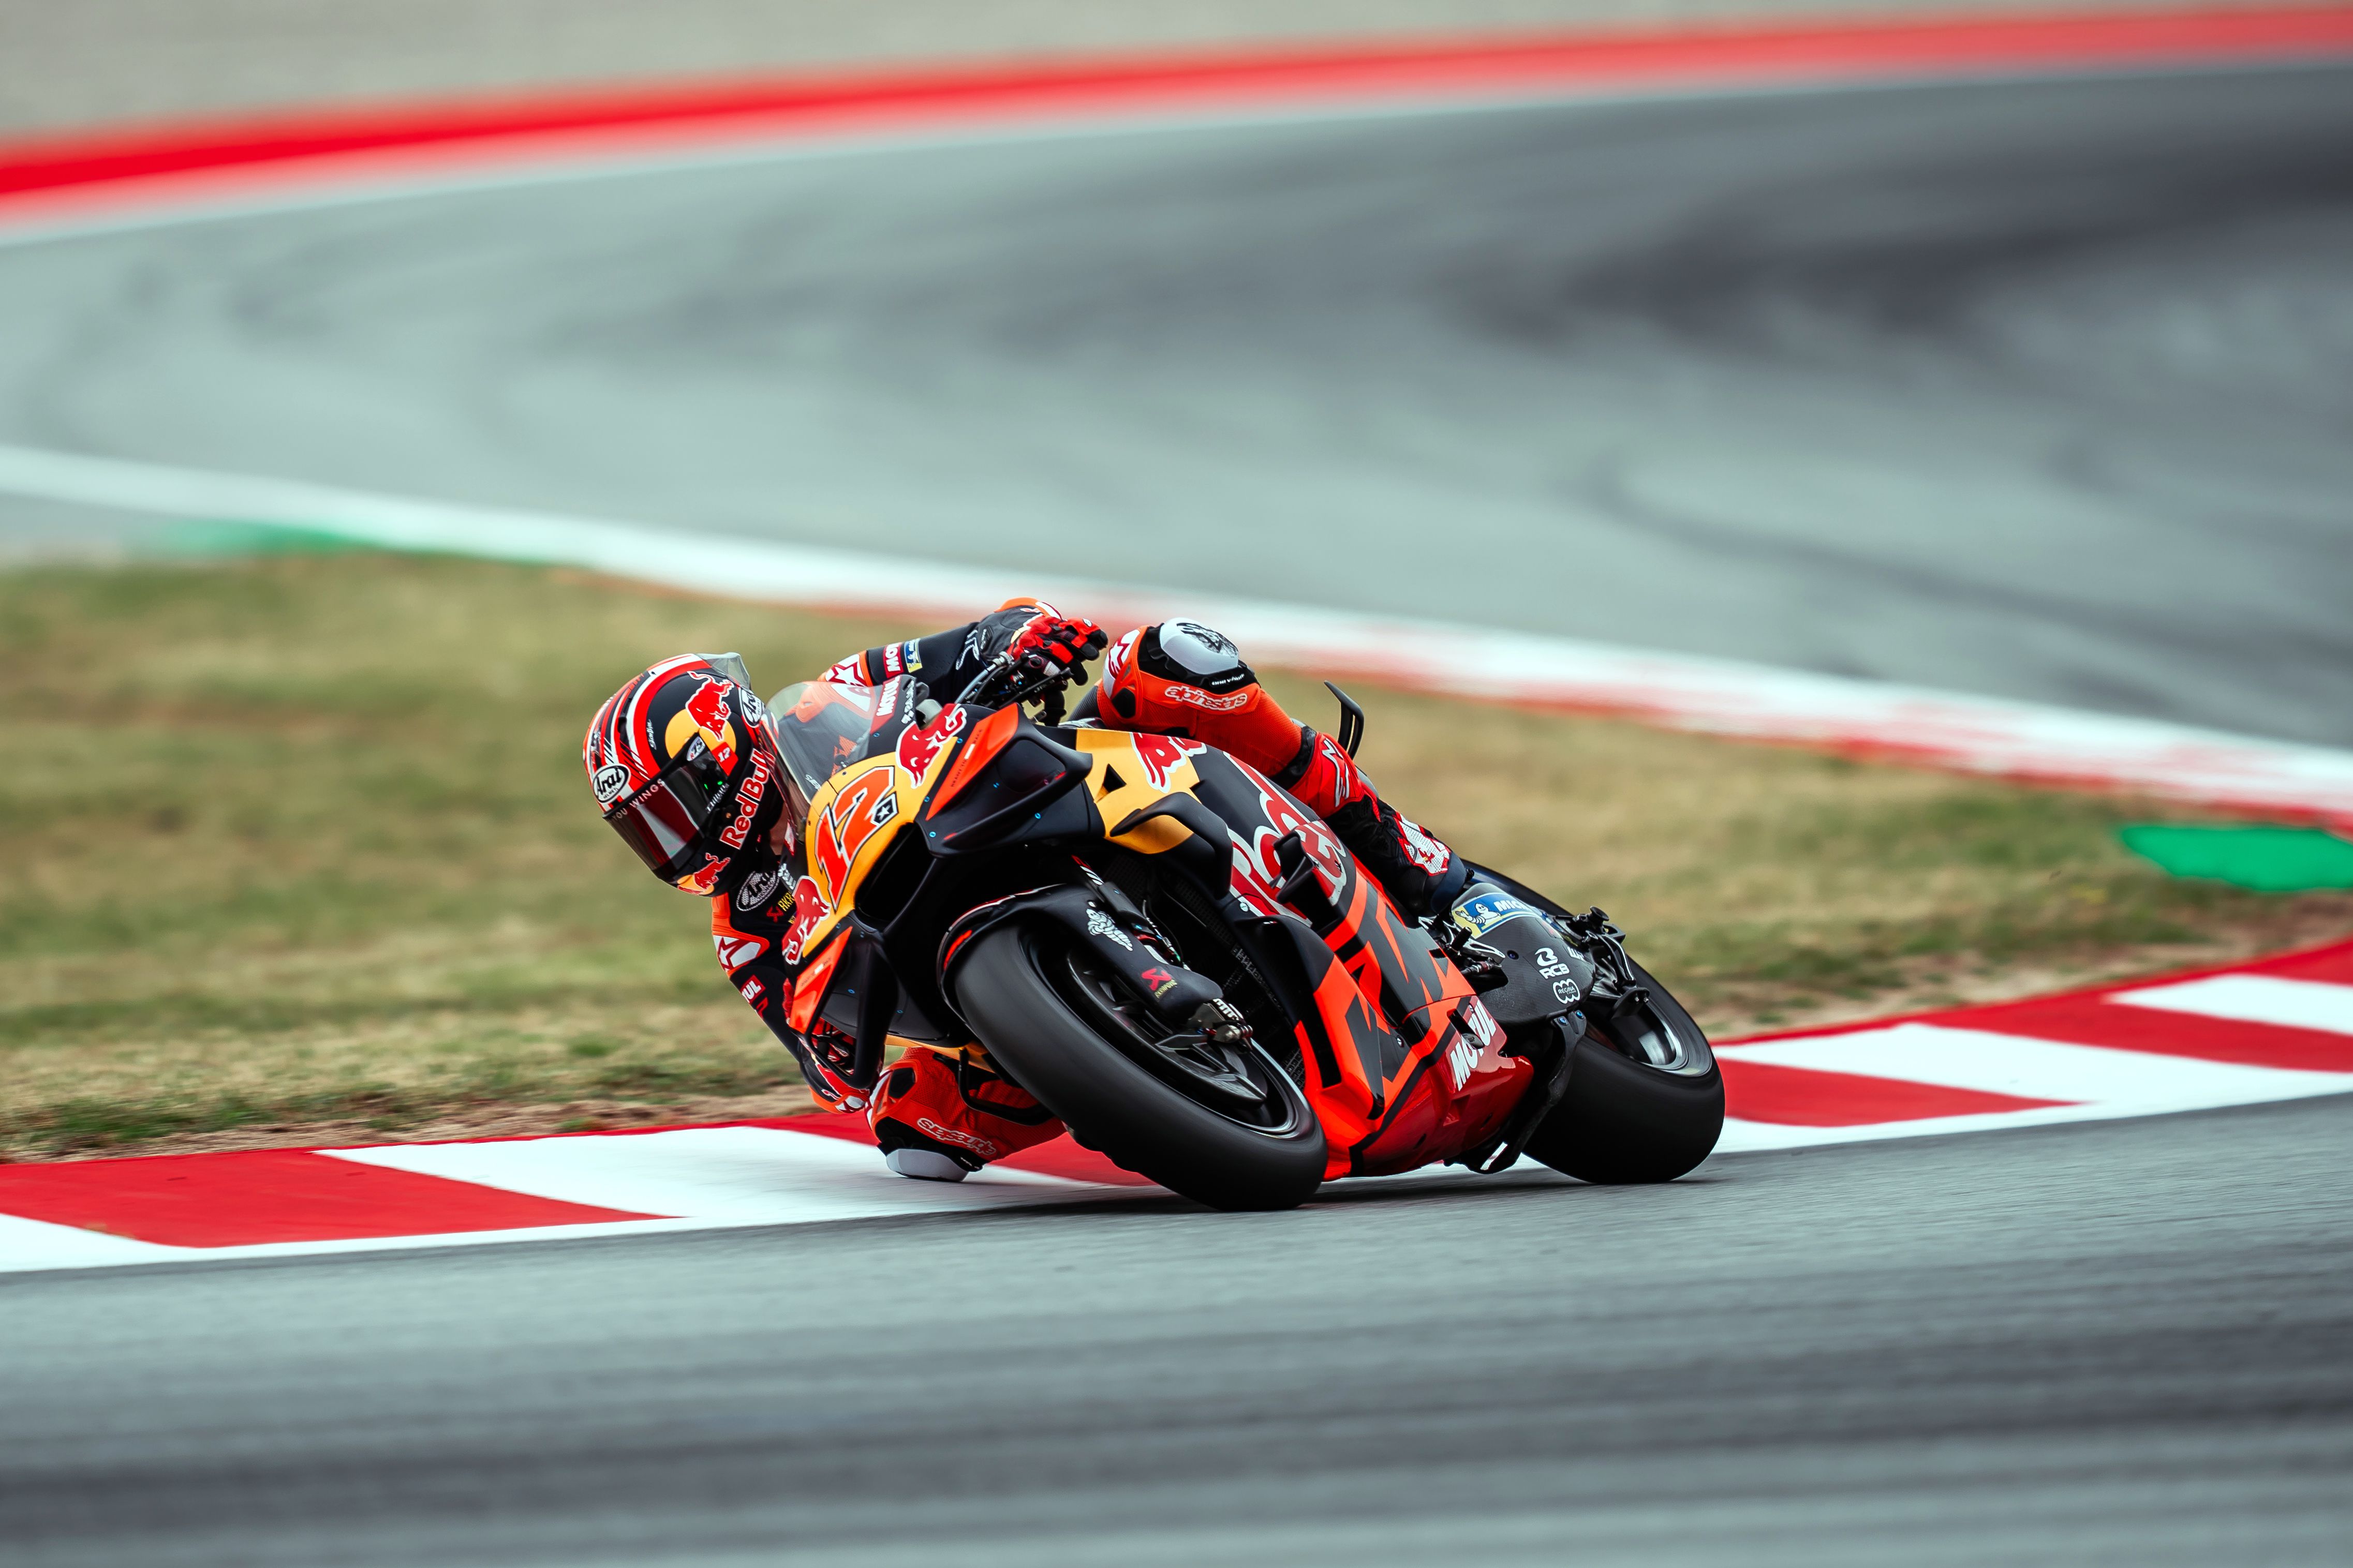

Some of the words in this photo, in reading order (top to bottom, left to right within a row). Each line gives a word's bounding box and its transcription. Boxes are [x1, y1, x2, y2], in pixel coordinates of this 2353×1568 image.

[718, 746, 731, 763] 12
[595, 767, 622, 797] Arai
[629, 778, 665, 809] WINGS
[719, 793, 759, 849] Red
[740, 748, 775, 801] Bull
[815, 765, 895, 913] 12
[1539, 963, 1570, 979] RCB
[1558, 985, 1575, 994] REGINA
